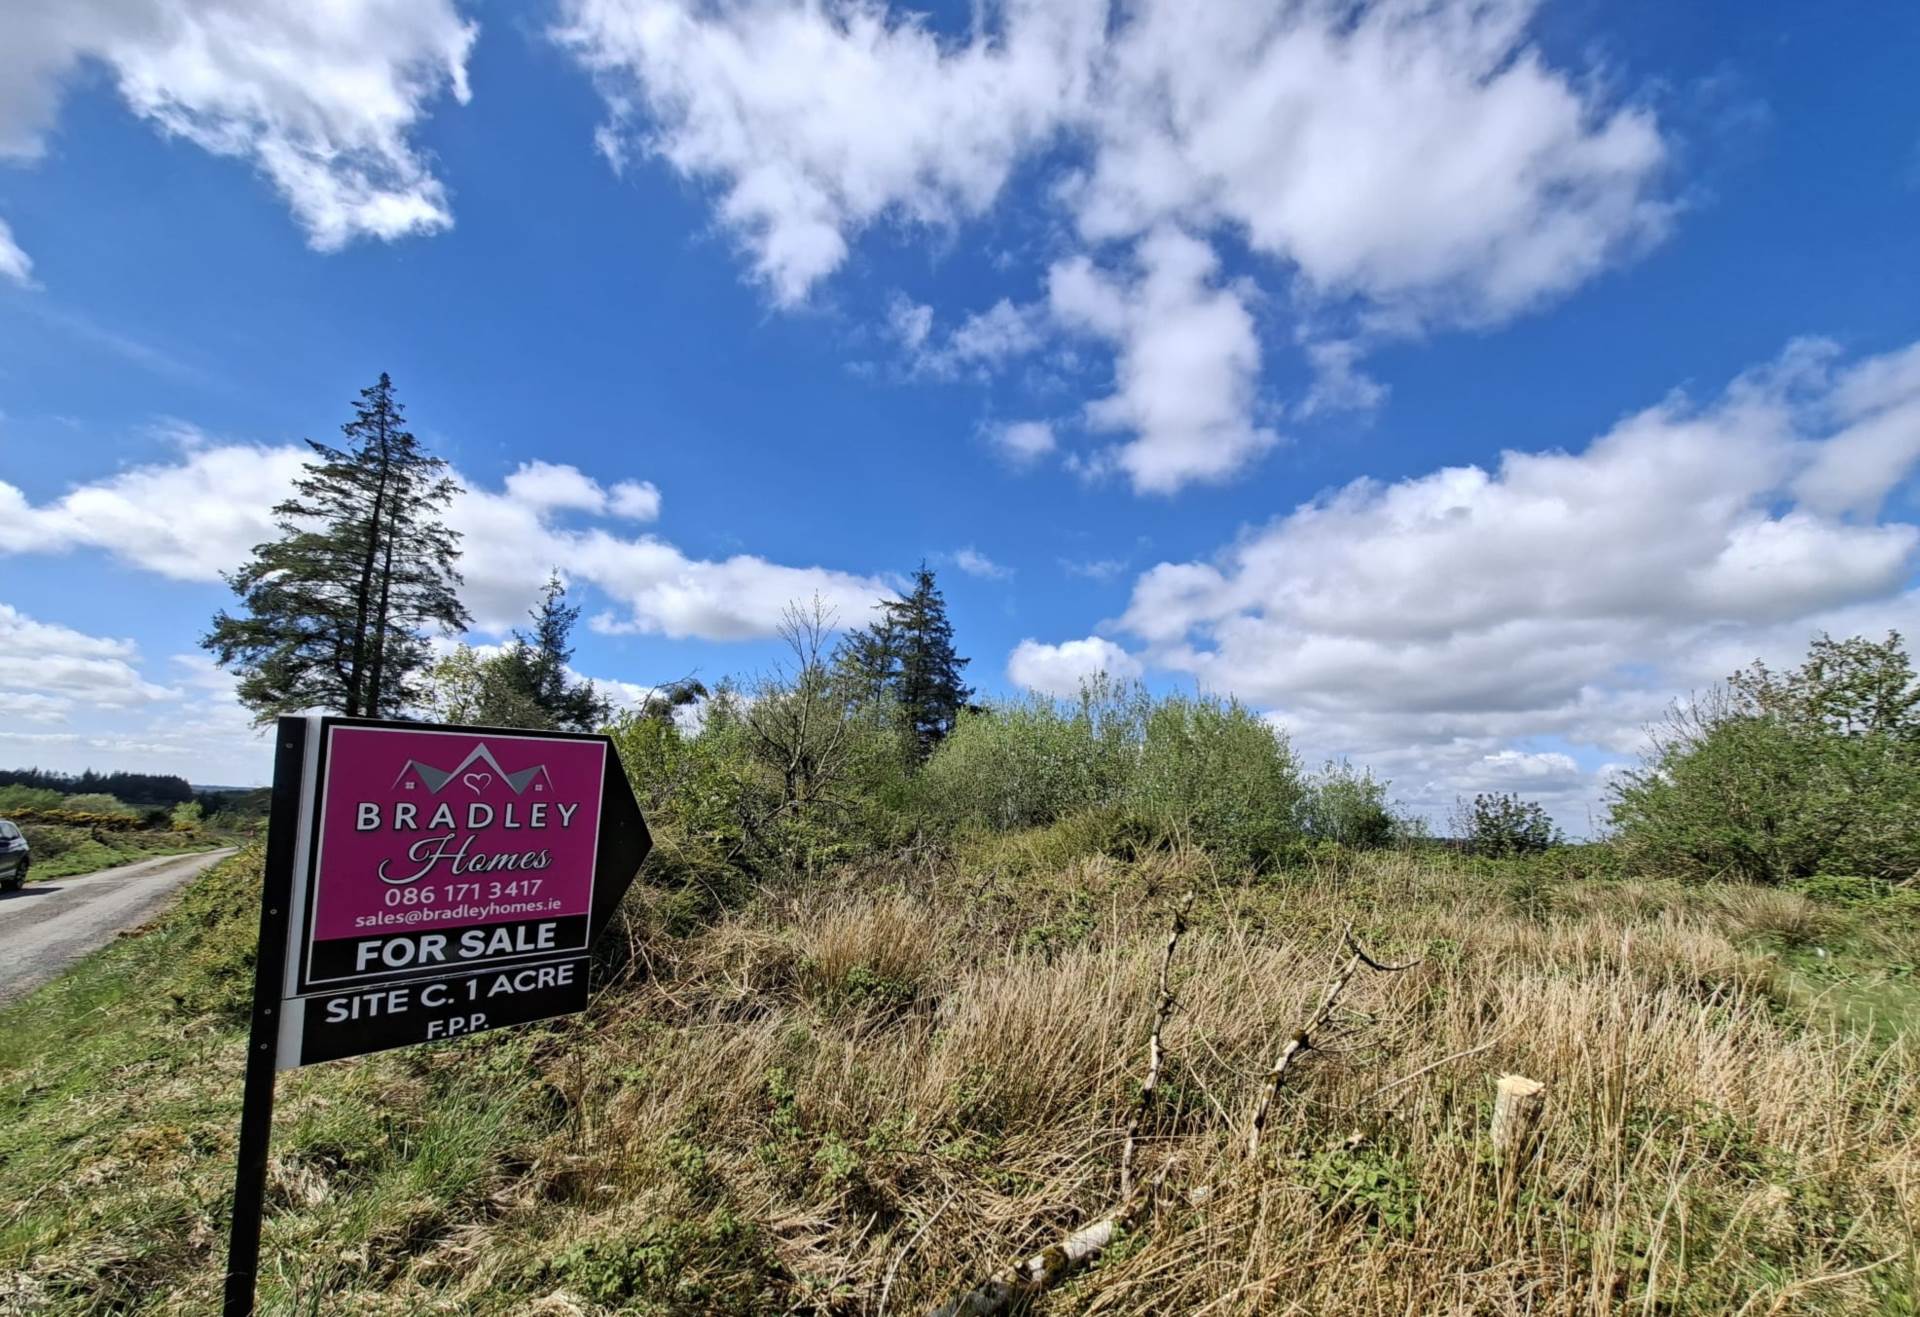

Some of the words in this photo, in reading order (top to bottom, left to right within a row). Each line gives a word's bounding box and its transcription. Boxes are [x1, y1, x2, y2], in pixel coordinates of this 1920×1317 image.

[356, 802, 579, 832] BRADLEY
[378, 833, 553, 884] Homes
[384, 887, 435, 907] 086
[444, 883, 480, 903] 171
[488, 879, 543, 899] 3417
[354, 898, 562, 928] sales@bradleyhomes.ie
[355, 934, 447, 971] FOR
[458, 922, 557, 957] SALE
[325, 989, 409, 1023] SITE
[420, 983, 455, 1008] C.
[466, 979, 478, 1000] 1
[487, 964, 574, 998] ACRE
[426, 1013, 489, 1040] F.P.P.
